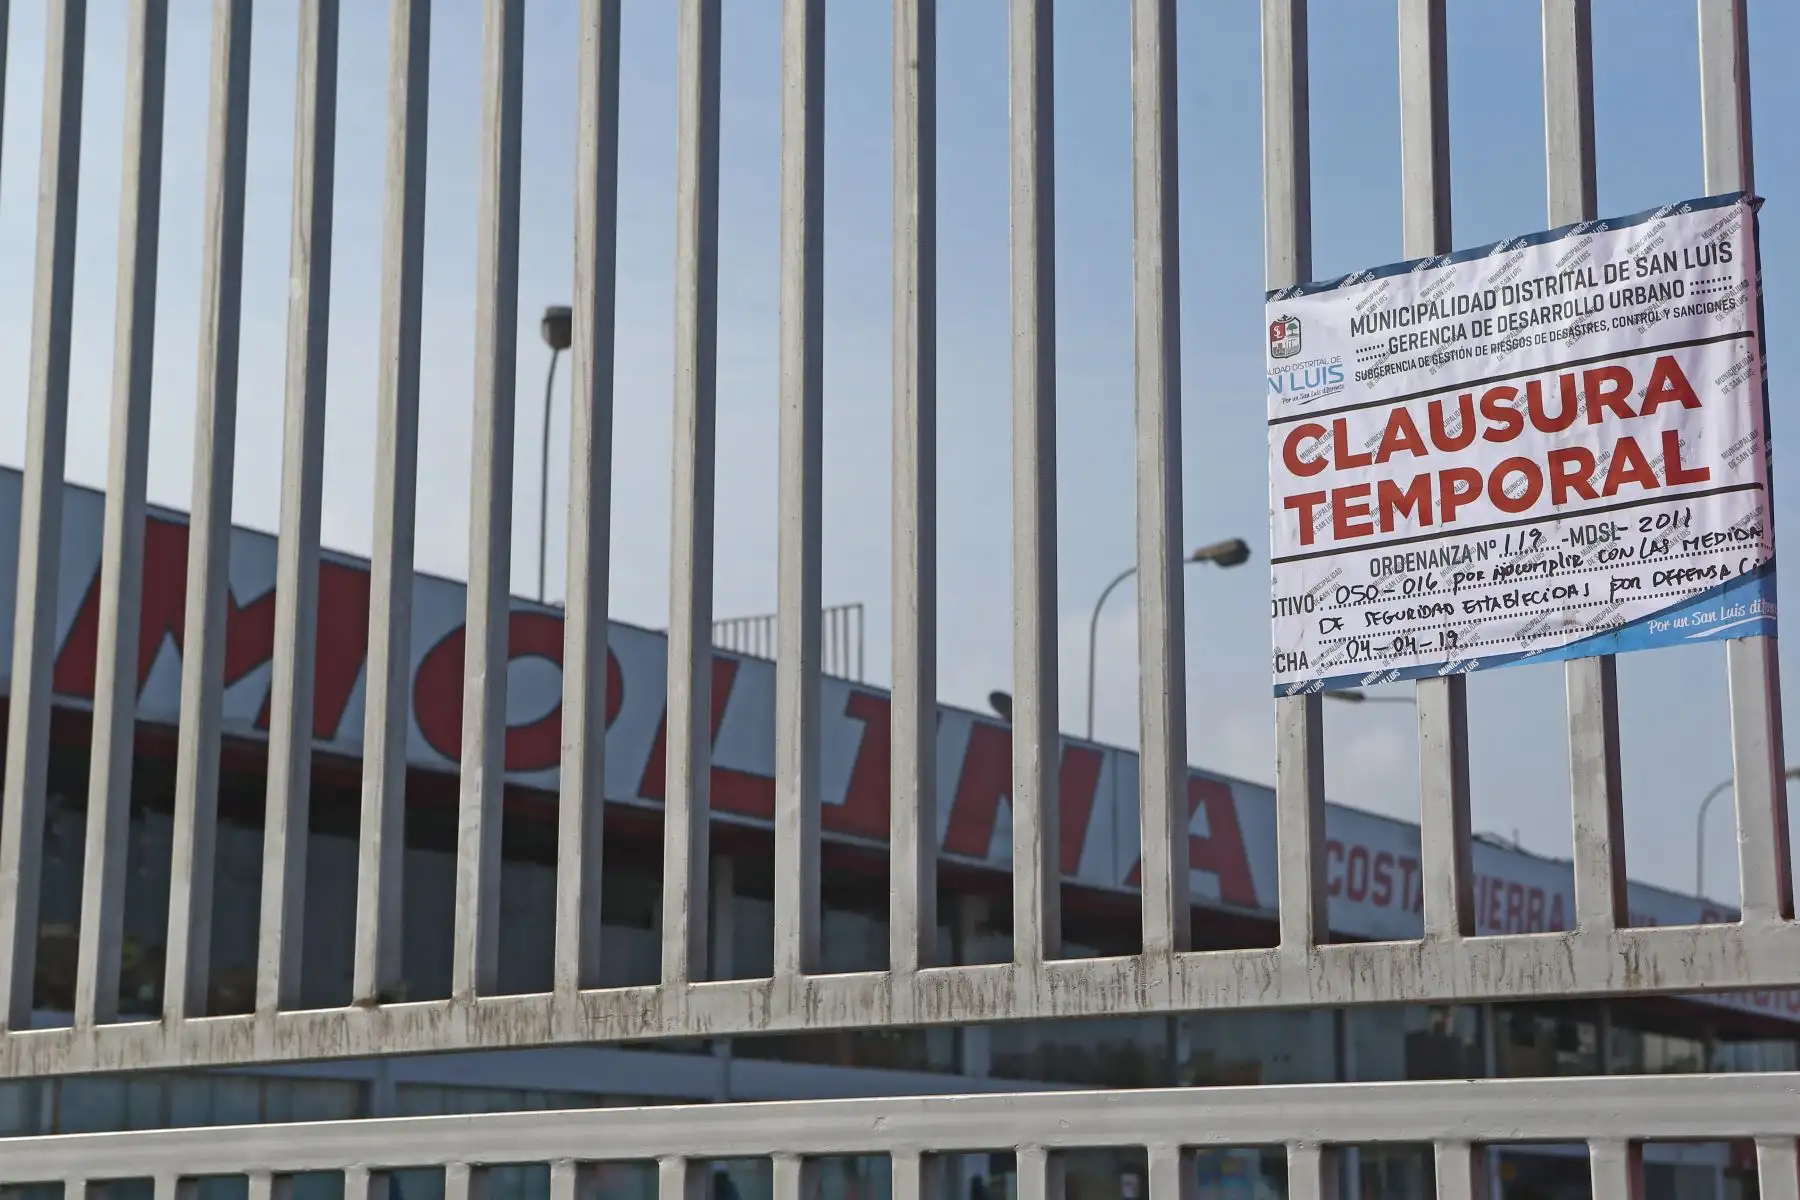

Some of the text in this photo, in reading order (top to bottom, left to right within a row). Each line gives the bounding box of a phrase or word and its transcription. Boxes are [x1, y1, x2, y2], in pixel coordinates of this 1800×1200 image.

[1351, 241, 1733, 337] MUNICIPALIDAD DISTRITAL DE SAN LUIS
[1388, 323, 1467, 354] GERENCIA
[1472, 319, 1493, 339] DE
[1497, 294, 1604, 333] DESARROLLO
[1609, 279, 1685, 309] URBANO
[1292, 358, 1329, 371] DISTRITAL
[1330, 355, 1342, 364] DE
[1355, 360, 1417, 381] SUBGERENCIA
[1419, 355, 1430, 368] DE
[1432, 345, 1473, 366] GESTIÓN
[1475, 345, 1489, 357] DE
[1490, 335, 1532, 355] RIESGOS
[1534, 332, 1547, 345] DE
[1549, 320, 1610, 342] DESASTRES,
[1612, 309, 1662, 329] CONTROL
[1661, 308, 1671, 320] Y
[1673, 297, 1736, 318] SANCIONES
[1290, 364, 1345, 391] LUIS
[1283, 355, 1702, 477] CLAUSURA
[1284, 430, 1710, 546] TEMPORAL
[1370, 543, 1472, 577] ORDENANZA
[1648, 620, 1671, 635] Por
[1673, 616, 1689, 629] un
[1691, 611, 1717, 626] San
[1720, 603, 1746, 621] Luis
[1272, 651, 1309, 674] CHA
[1324, 839, 1565, 933] COST IERRA
